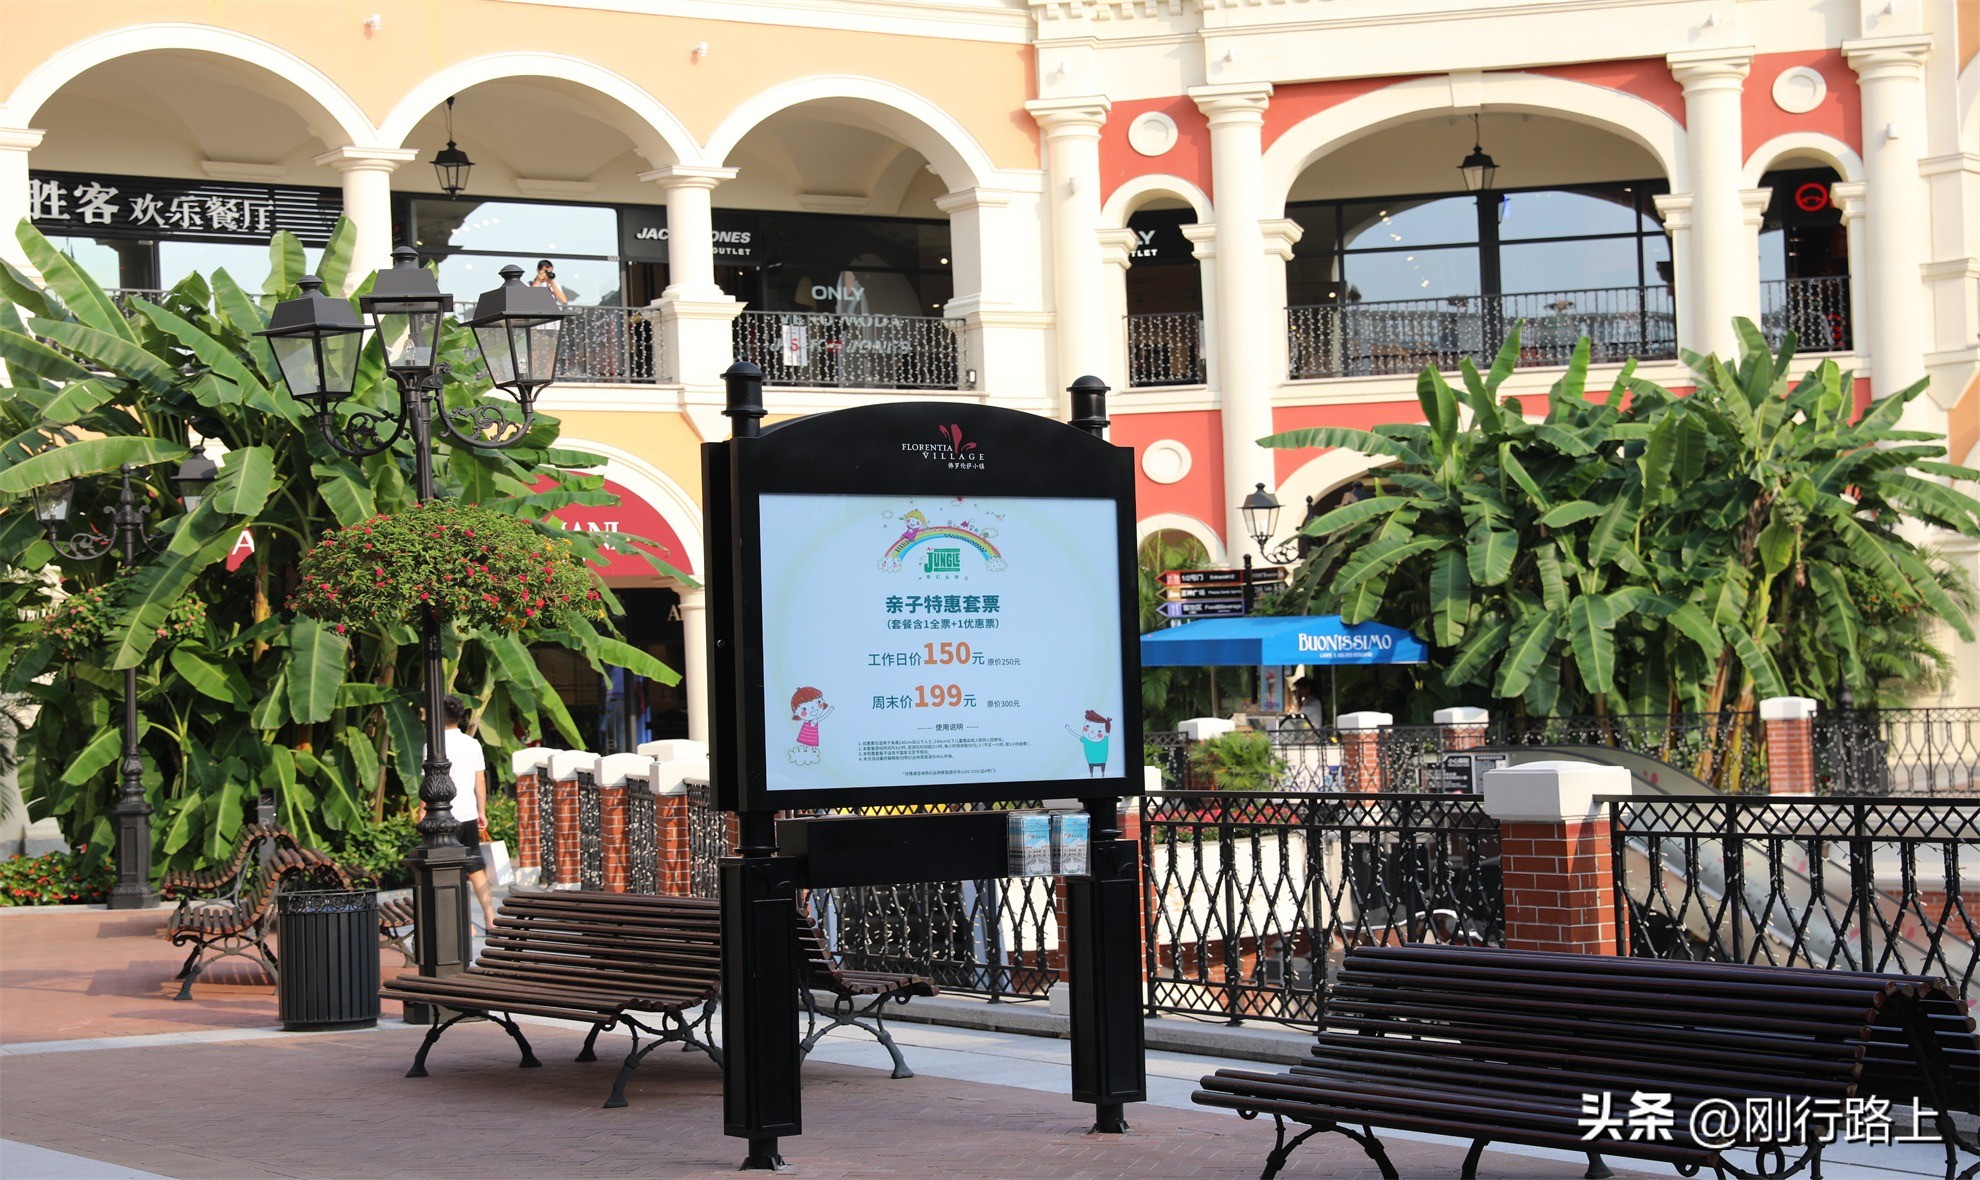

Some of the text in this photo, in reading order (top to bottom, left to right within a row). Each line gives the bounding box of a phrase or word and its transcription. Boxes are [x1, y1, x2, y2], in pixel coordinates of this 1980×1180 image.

[29, 178, 275, 231] 胜客 欢乐餐厅
[636, 227, 669, 241] JAC
[811, 285, 865, 301] ONLY
[901, 443, 953, 452] FLORENTIA
[923, 452, 984, 461] VILLAGE
[924, 552, 960, 573] JUNGLE
[885, 595, 1000, 614] 亲子特惠套票
[887, 618, 1000, 630] (套餐含1全票+1优惠票)
[1298, 633, 1392, 652] BUONISSIMO
[868, 642, 1021, 667] 工作日价150元 原价250元
[872, 684, 1021, 710] 周末价199元 原价300元
[935, 723, 964, 731] 使用说明
